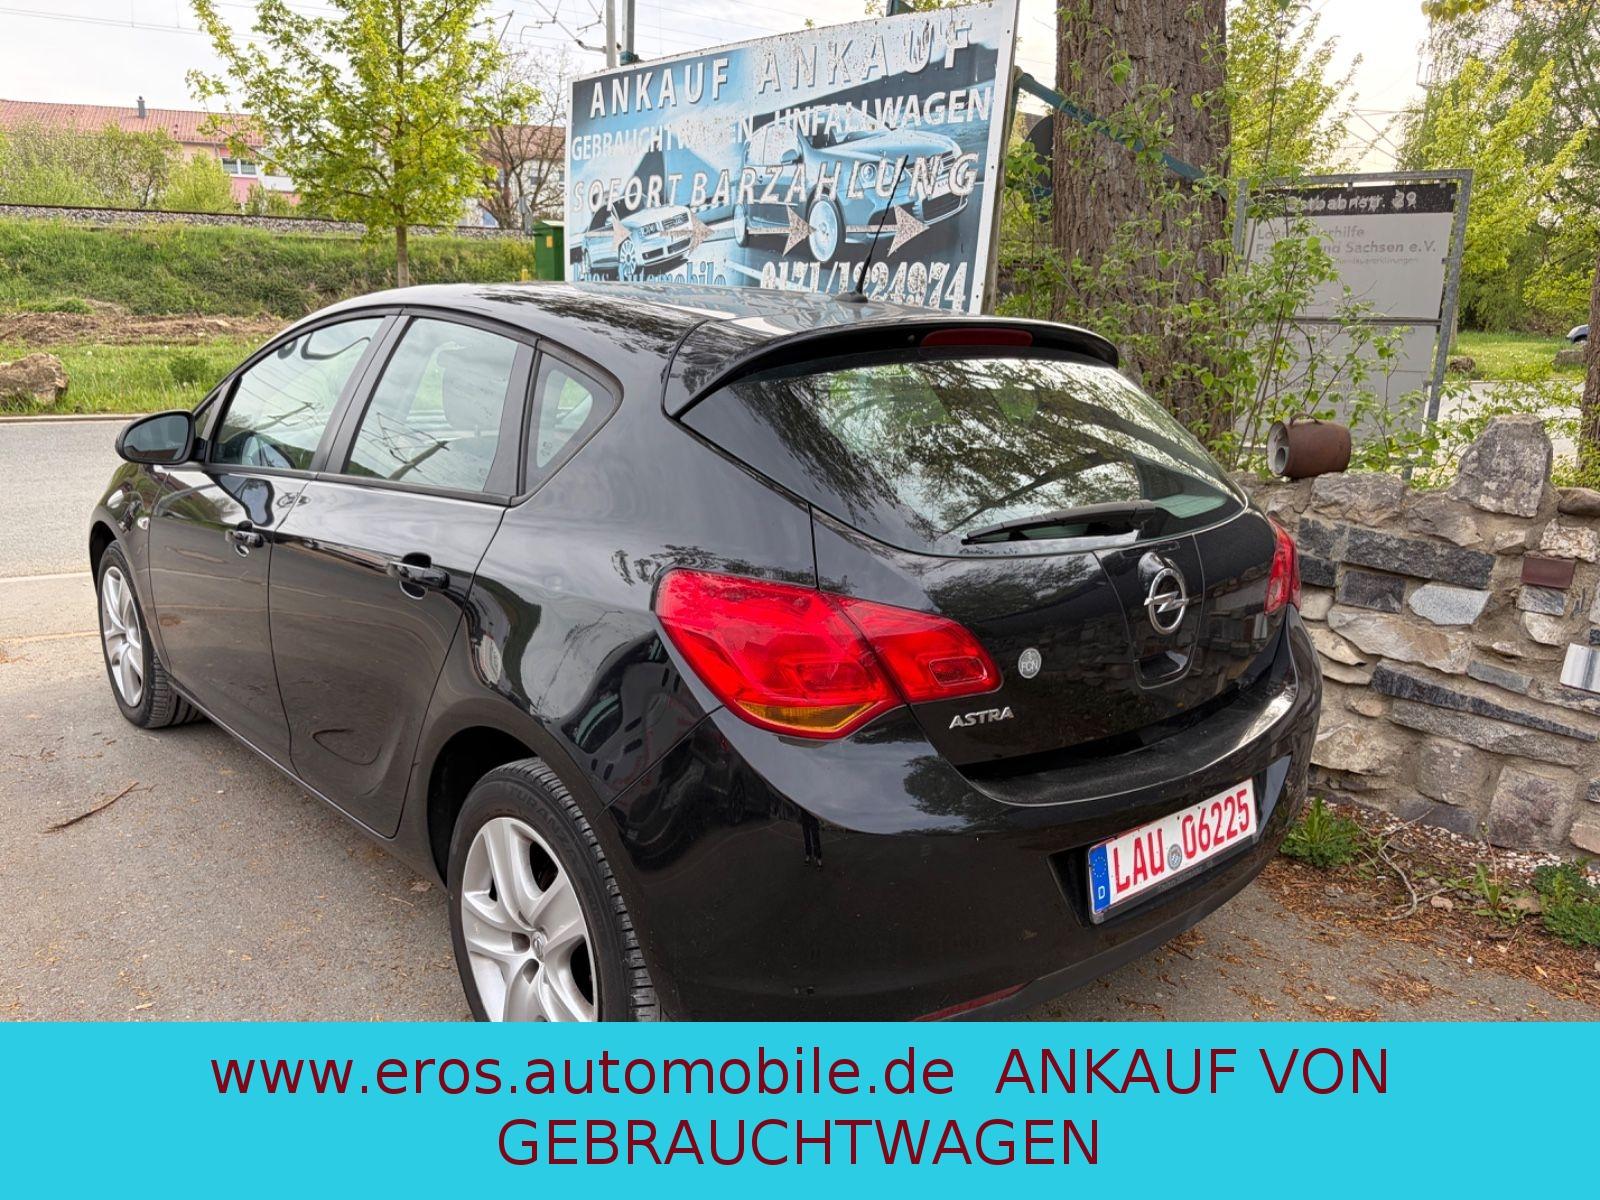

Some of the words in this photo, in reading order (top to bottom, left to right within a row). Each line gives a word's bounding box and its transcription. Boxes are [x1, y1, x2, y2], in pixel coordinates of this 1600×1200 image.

[589, 58, 729, 118] ANKAUF
[757, 18, 973, 94] ANKAUF
[571, 111, 754, 161] GEBRAUCHTWEN
[573, 173, 683, 213] SOFORT
[690, 152, 979, 212] BARZAHLUNG
[1345, 240, 1404, 254] Sachsen
[1409, 240, 1436, 253] e.V.
[949, 706, 1014, 729] ASTRA
[1113, 828, 1165, 894] LAU
[1181, 788, 1250, 859] 06225
[1098, 886, 1106, 900] D
